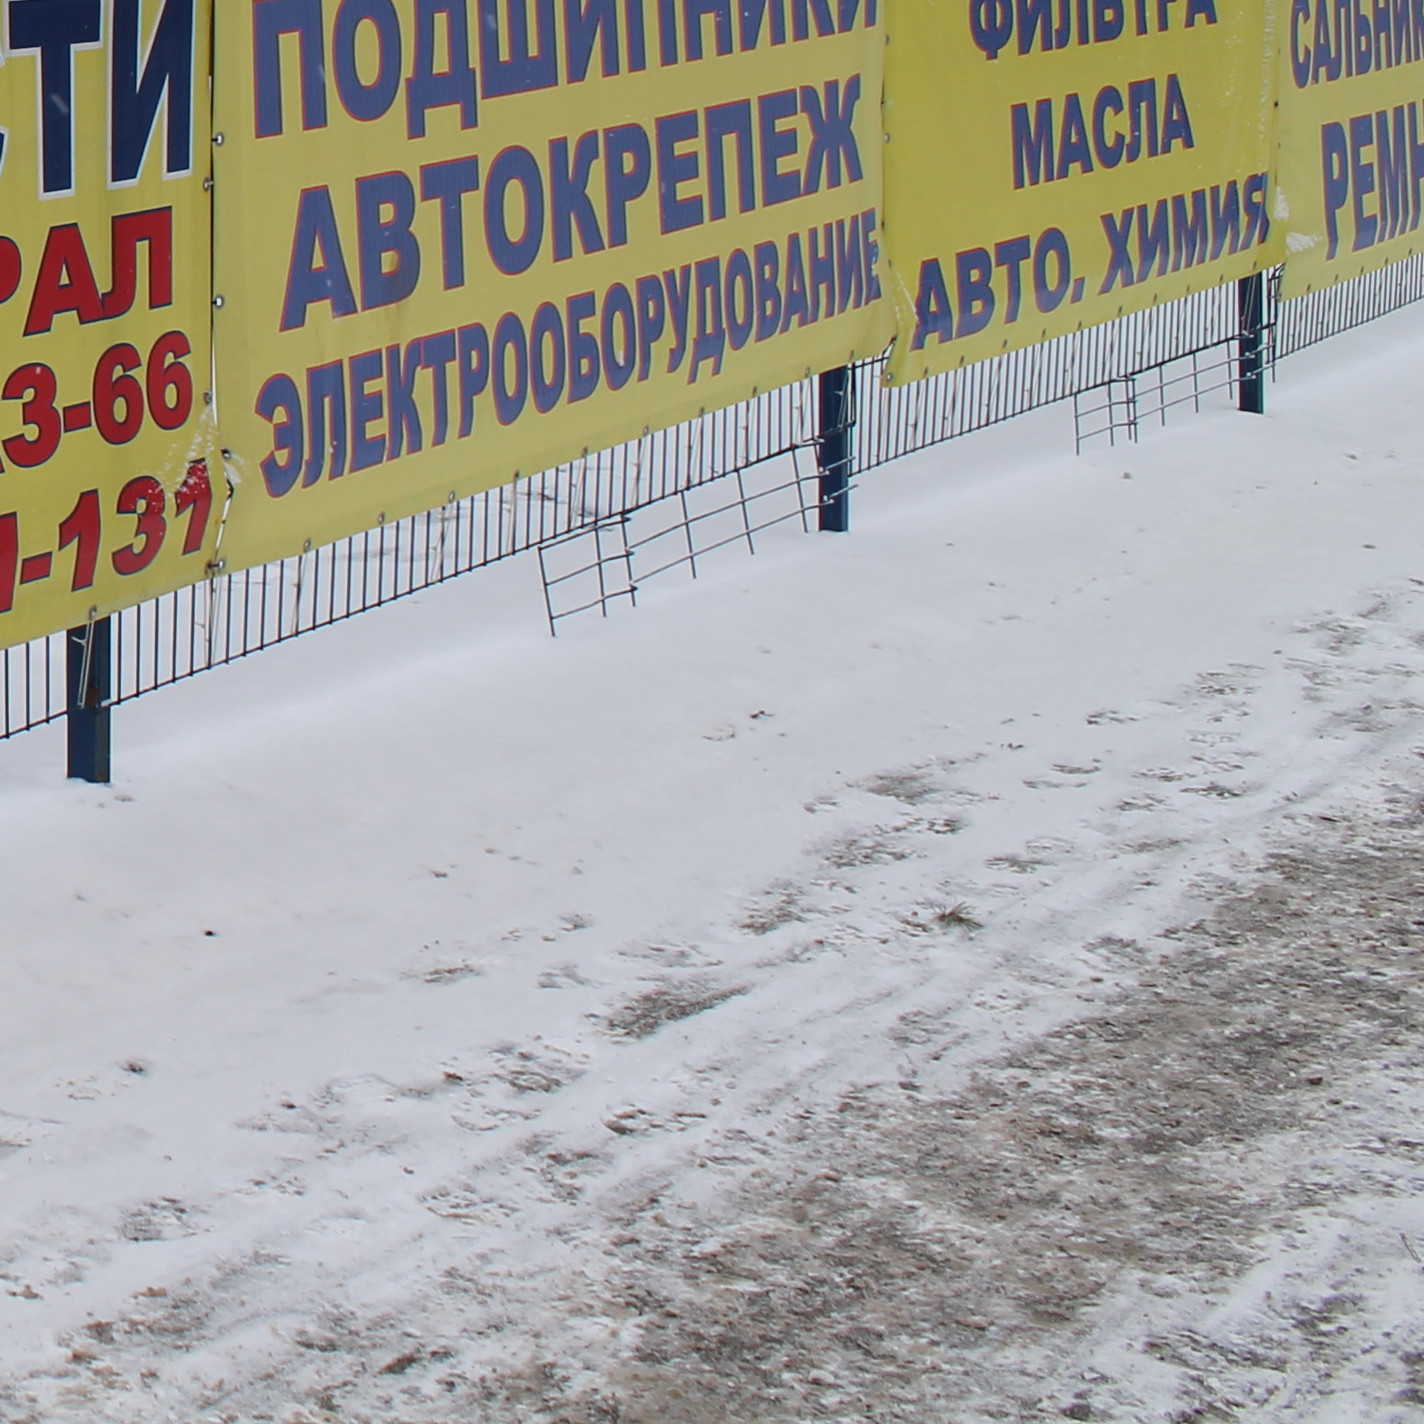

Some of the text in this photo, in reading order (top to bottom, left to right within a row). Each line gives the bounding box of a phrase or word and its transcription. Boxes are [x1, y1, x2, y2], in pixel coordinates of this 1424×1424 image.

[278, 72, 864, 333] АВТОКРЕПЕЖ
[1009, 73, 1195, 191] МАСЛА
[1098, 169, 1270, 296] ХИМИЯ
[254, 207, 882, 499] ЭЛЕКТРООБОРУДОВАНИЕ
